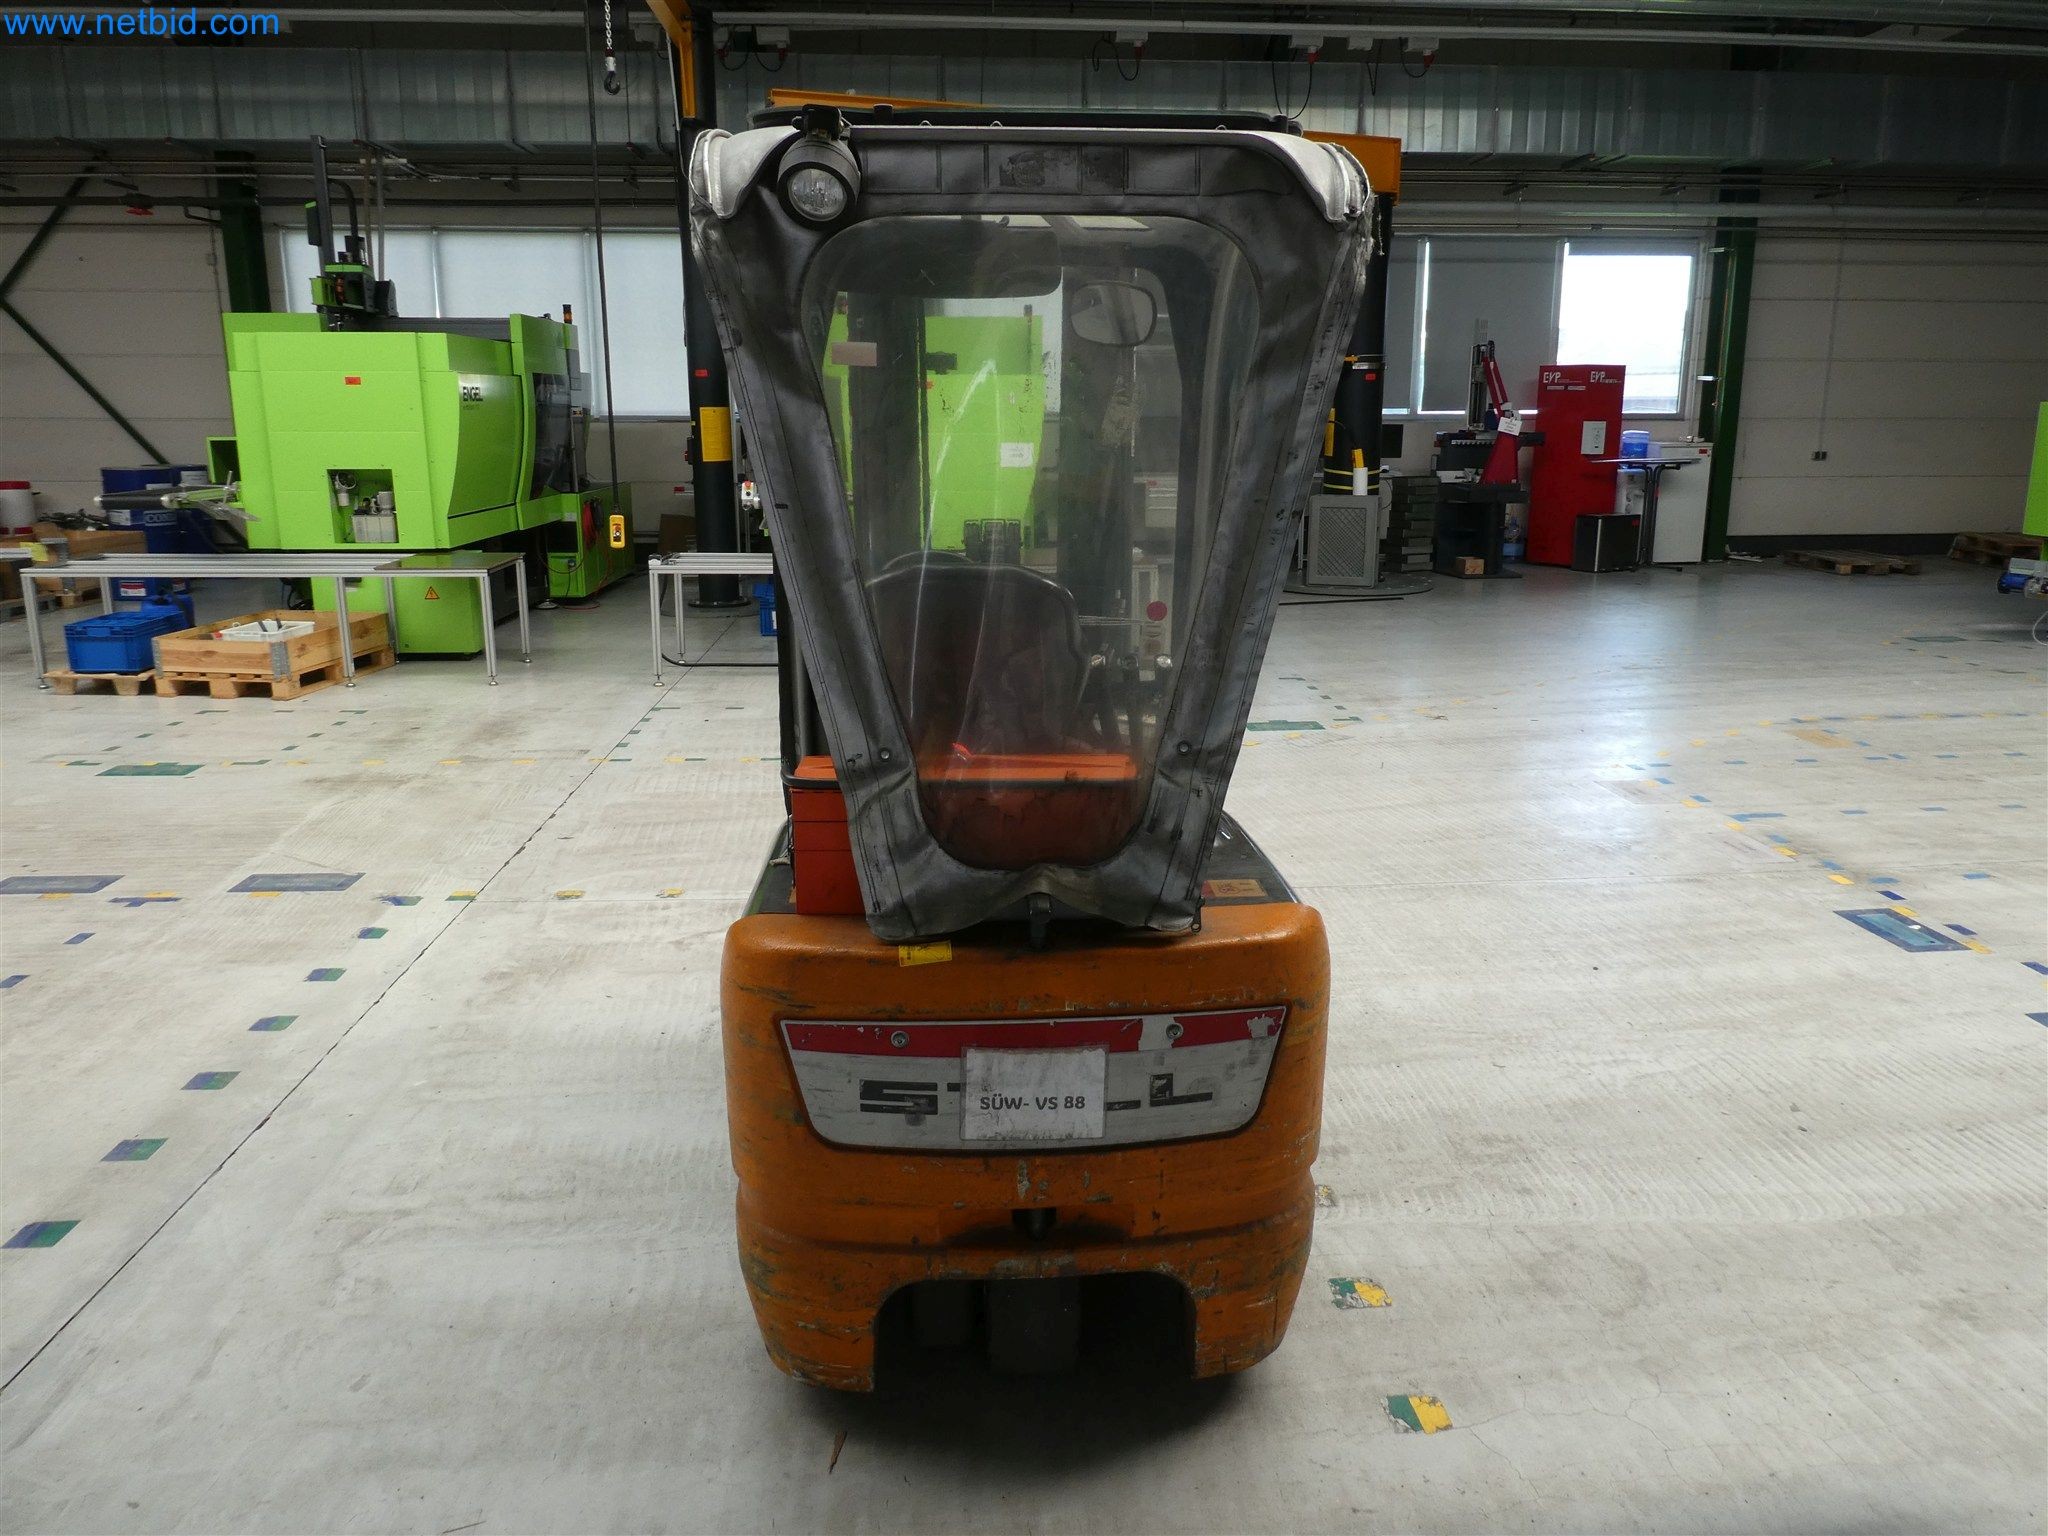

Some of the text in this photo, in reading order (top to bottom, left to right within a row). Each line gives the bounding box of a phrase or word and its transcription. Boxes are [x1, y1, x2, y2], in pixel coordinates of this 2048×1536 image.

[980, 1093, 1085, 1110] SÜW- VS 88
